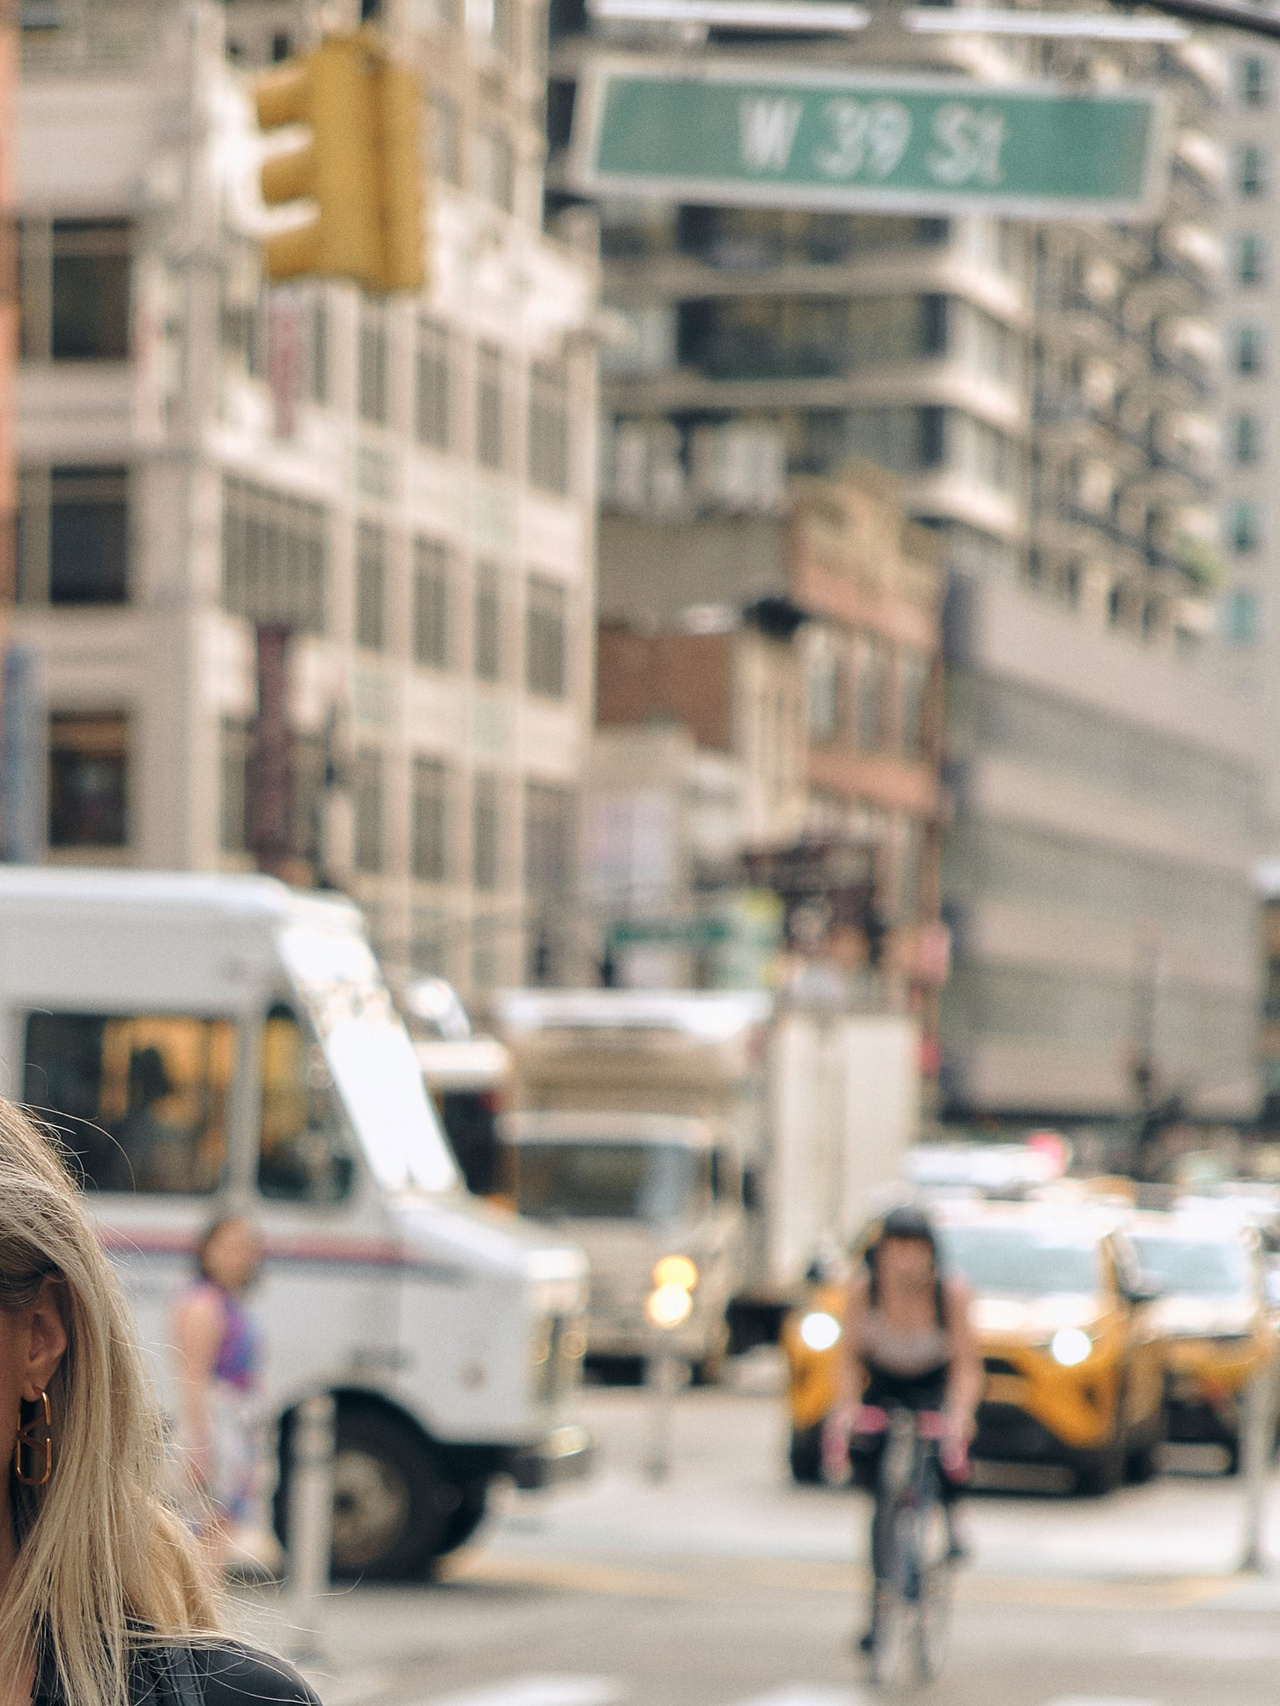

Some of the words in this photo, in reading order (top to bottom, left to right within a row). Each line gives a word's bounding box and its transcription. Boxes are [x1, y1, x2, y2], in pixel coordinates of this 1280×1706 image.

[738, 97, 803, 173] W
[817, 98, 912, 179] 39
[925, 102, 1007, 184] St
